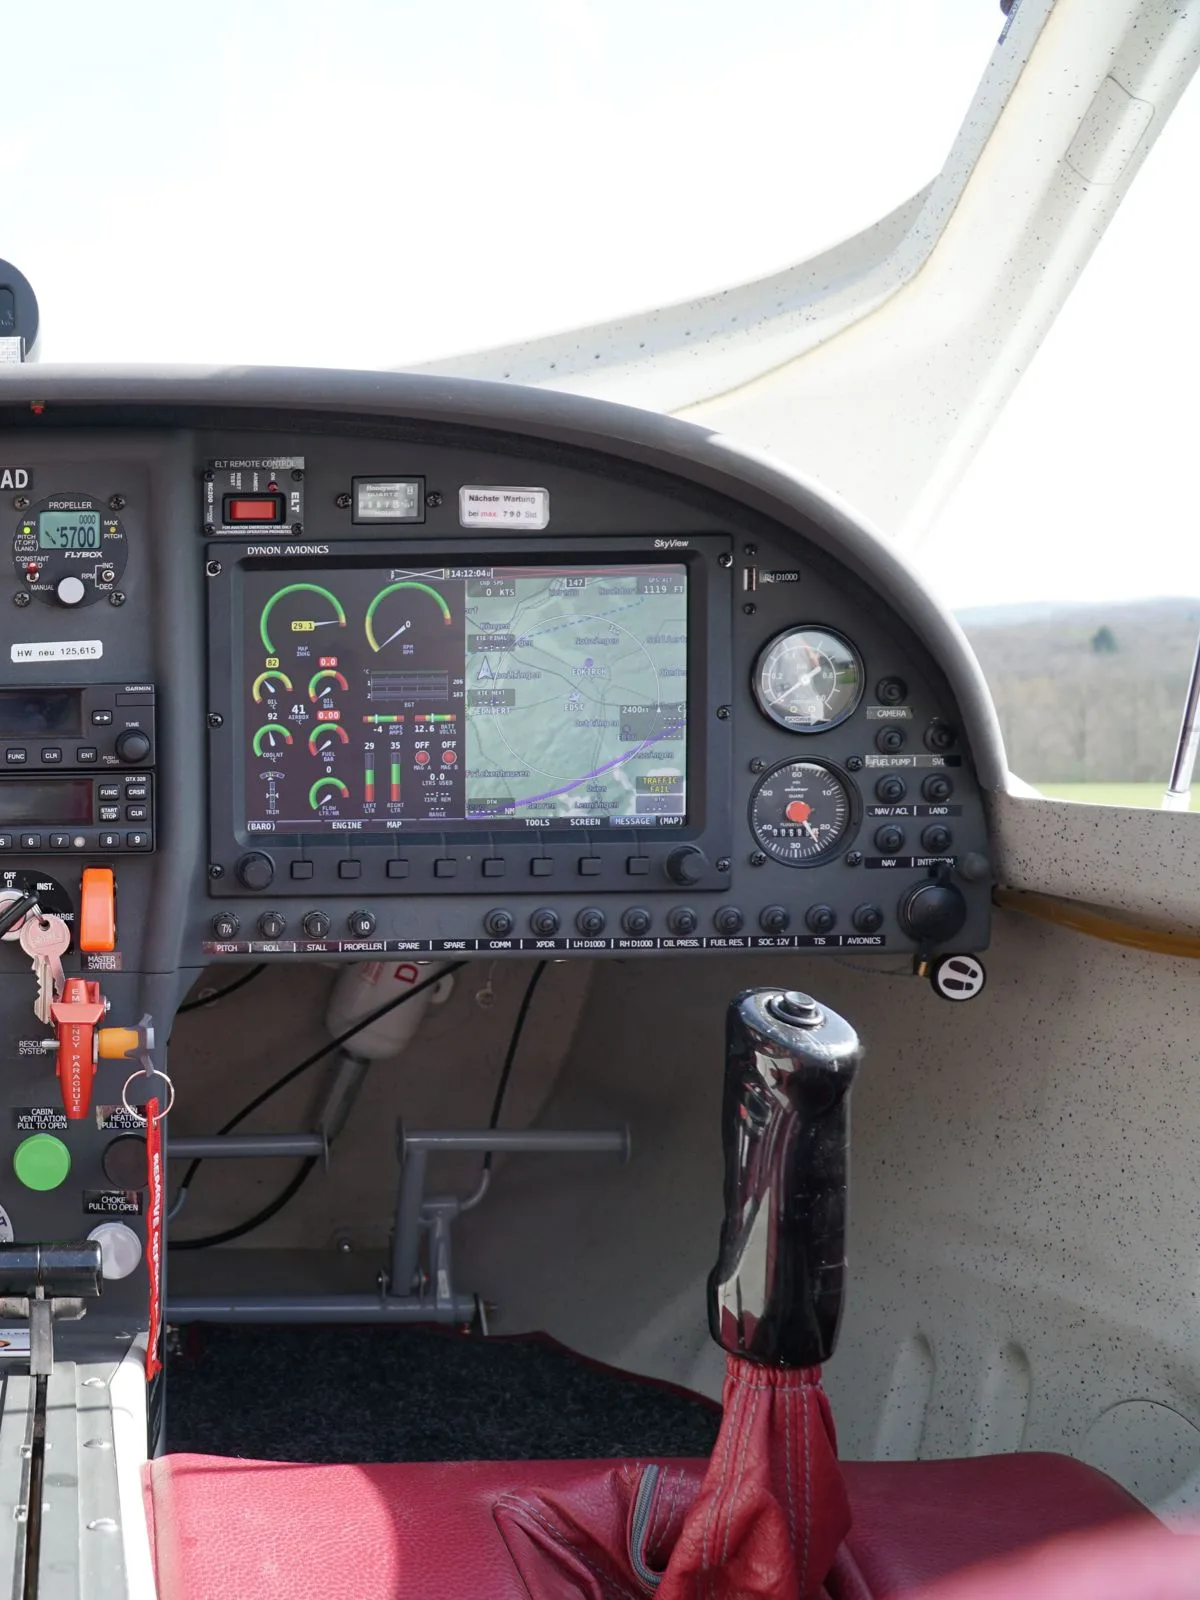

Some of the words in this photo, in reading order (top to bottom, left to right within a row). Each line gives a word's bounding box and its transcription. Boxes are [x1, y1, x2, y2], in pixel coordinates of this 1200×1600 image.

[291, 492, 299, 512] ELT
[503, 495, 535, 504] Wartung
[49, 501, 92, 509] PROPELLER
[59, 526, 96, 548] 5700
[654, 539, 689, 548] SkyView
[247, 546, 281, 554] DYNON
[285, 545, 329, 554] AVIONICS
[568, 579, 583, 587] 147
[644, 586, 667, 594] 1119
[293, 622, 313, 630] 29.1
[18, 648, 32, 657] HW
[39, 649, 55, 657] neu
[60, 646, 96, 656] 125,615
[291, 705, 306, 714] 41
[877, 709, 906, 717] CAMERA
[415, 725, 435, 733] 12.6
[8, 752, 24, 760] FUNC
[872, 758, 889, 766] FUEL
[891, 758, 911, 766] PUMP
[875, 807, 889, 815] NAV
[895, 807, 908, 815] ACL
[525, 819, 550, 827] TOOLS
[570, 818, 601, 826] SCREEN
[659, 817, 683, 826] (MAP)
[247, 823, 275, 831] (BARO)
[882, 859, 896, 867] NAV
[4, 872, 16, 880] OFF
[37, 882, 54, 891] INST.
[490, 941, 511, 949] COMM
[536, 941, 555, 949] XPDR
[574, 940, 583, 948] LH
[584, 940, 605, 948] D1000
[620, 940, 630, 948] RH
[632, 939, 653, 947] D1000
[663, 939, 674, 947] OIL
[675, 939, 699, 947] PRESS.
[710, 939, 726, 947] FUEL
[728, 938, 744, 946] RES.
[758, 938, 773, 946] SOC.
[776, 938, 790, 946] 12V
[847, 937, 881, 945] AVIONICS
[217, 944, 238, 952] PITCH
[263, 944, 280, 952] ROLL
[307, 943, 327, 952] STALL
[344, 942, 383, 951] PROPELLER
[398, 942, 419, 950] SPARE
[444, 941, 465, 950] SPARE
[72, 1056, 80, 1111] PARACHUTE
